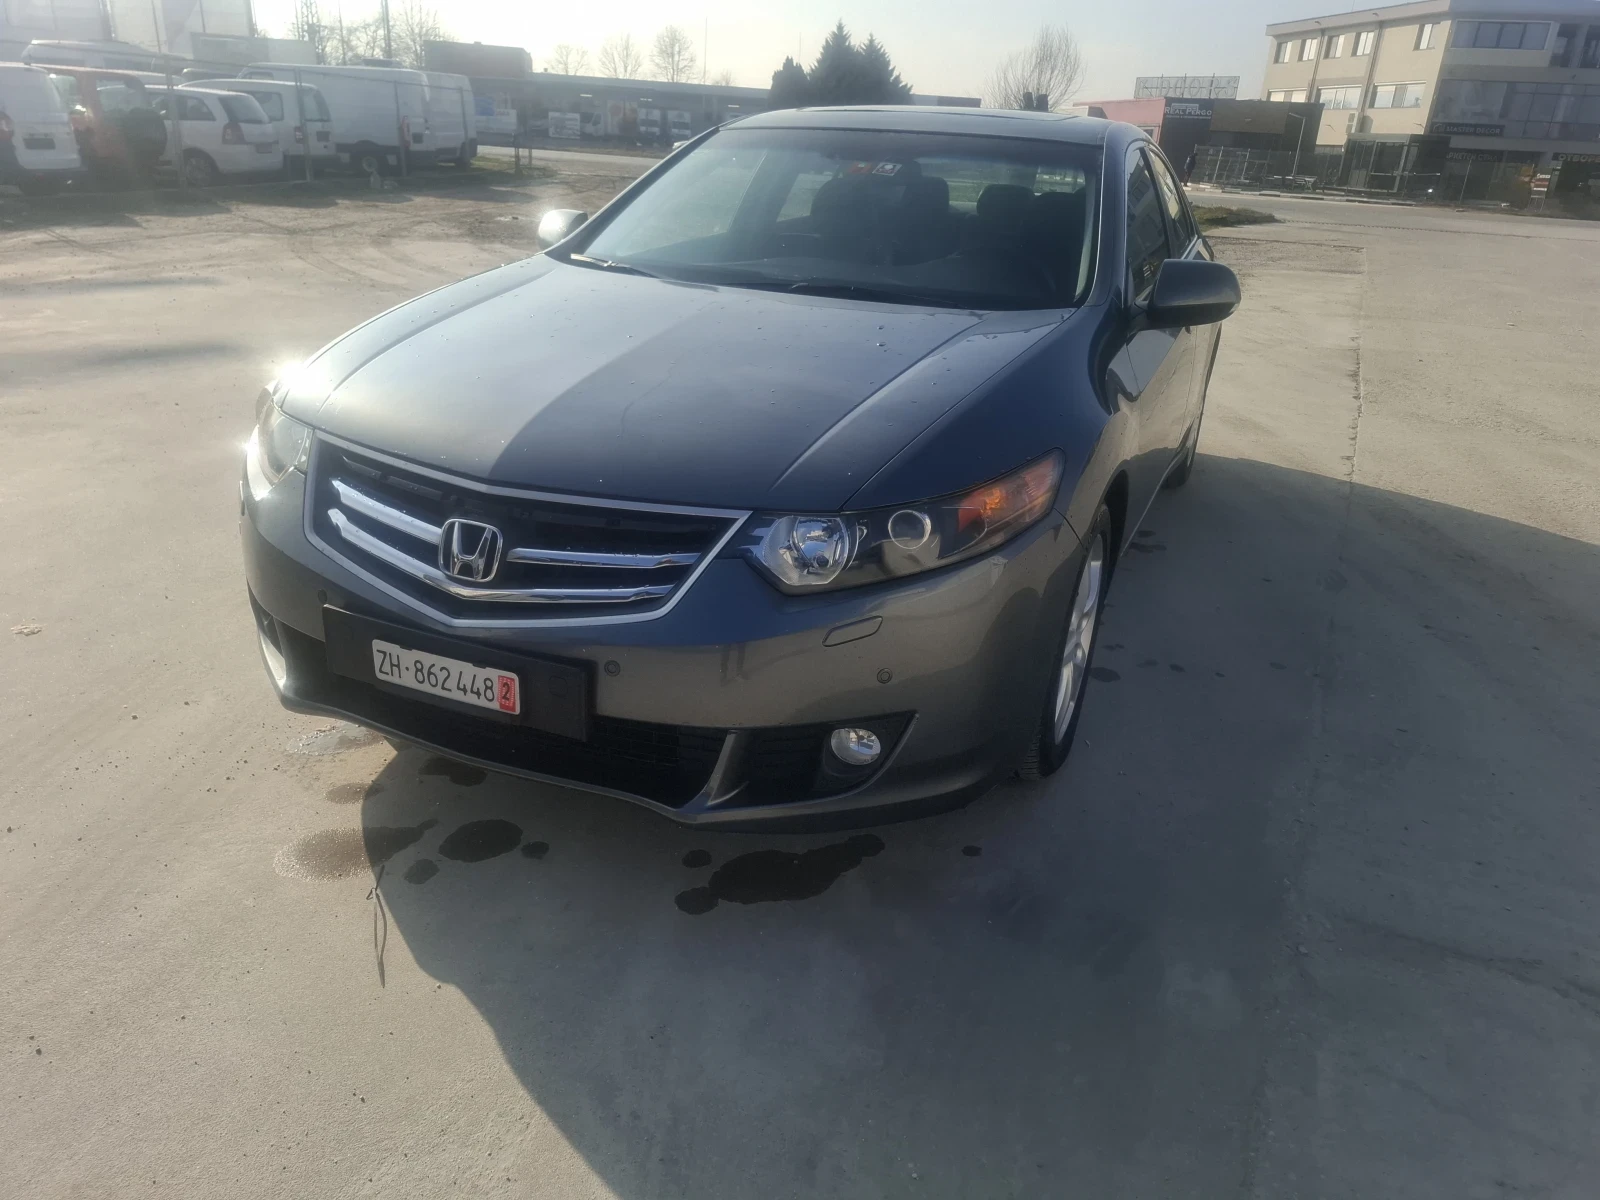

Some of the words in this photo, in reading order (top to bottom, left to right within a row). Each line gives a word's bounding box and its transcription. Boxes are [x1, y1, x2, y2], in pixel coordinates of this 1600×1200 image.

[1164, 106, 1184, 115] REAL
[1185, 107, 1212, 116] PERGO
[501, 682, 511, 701] 2
